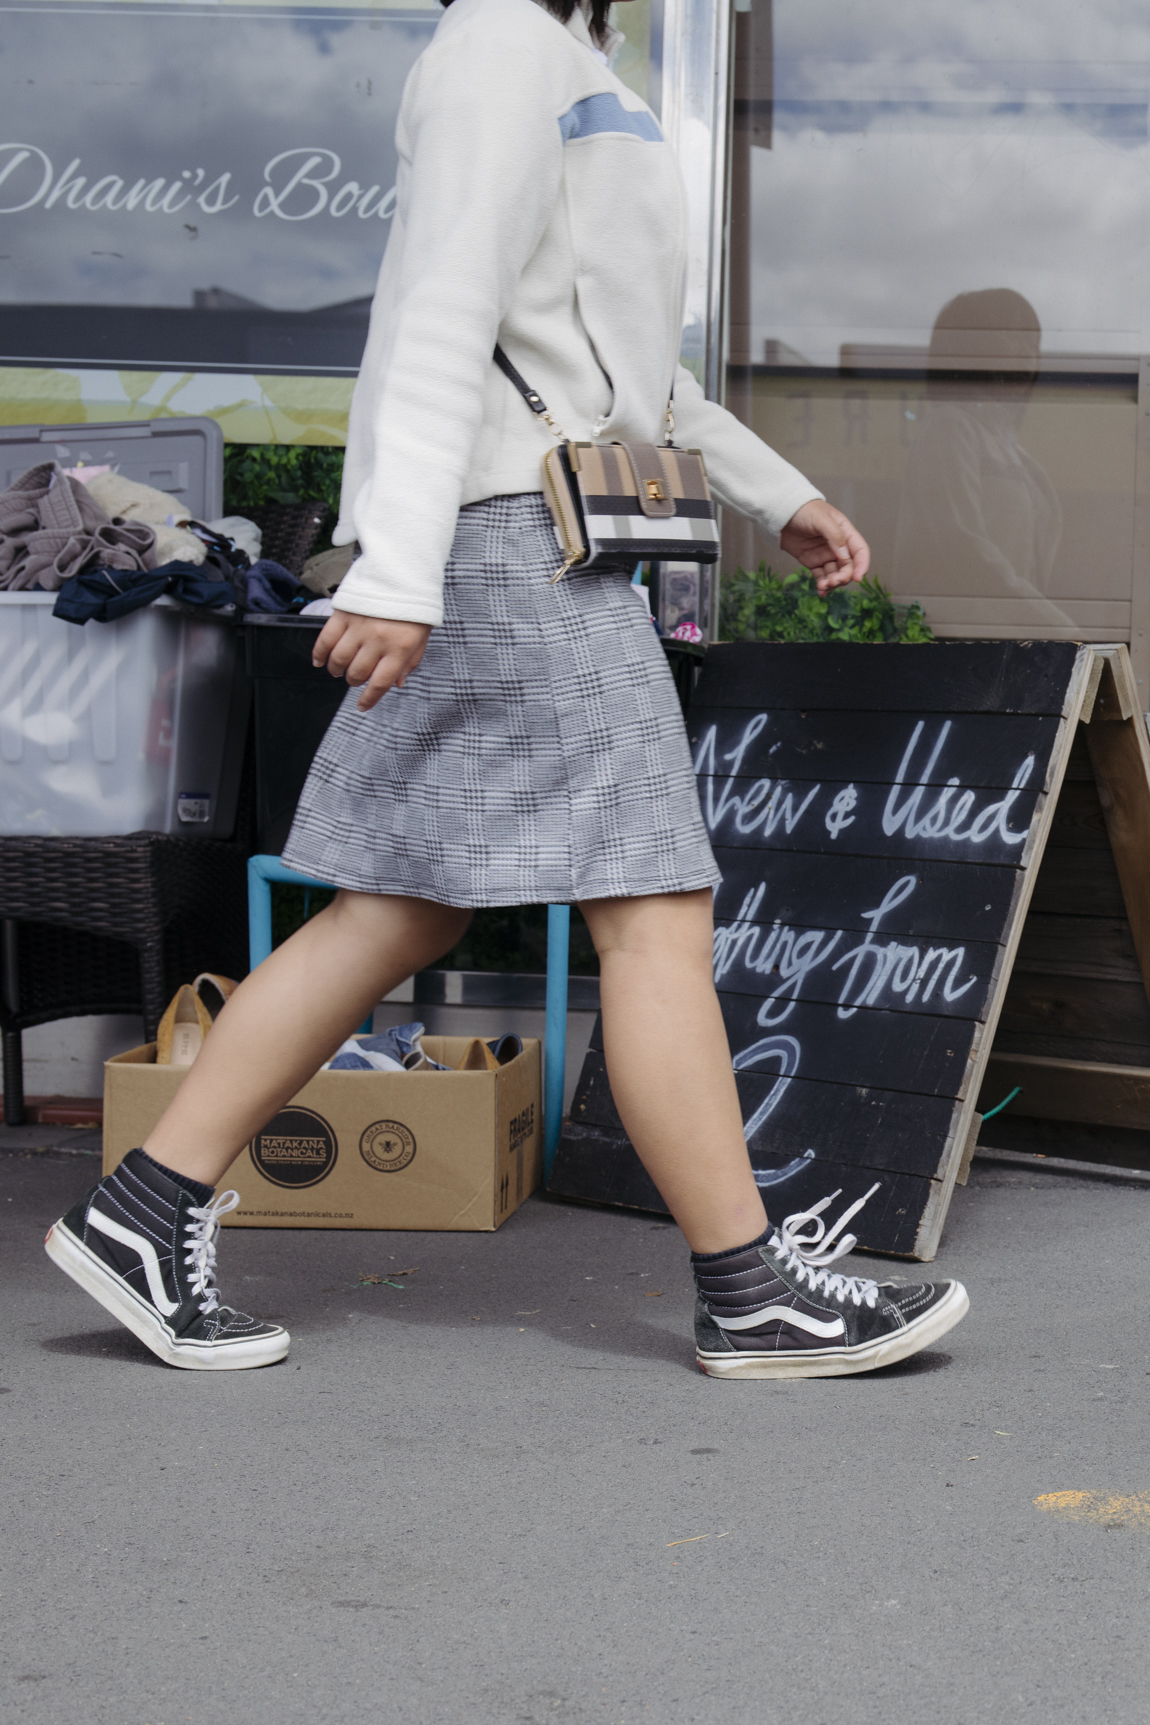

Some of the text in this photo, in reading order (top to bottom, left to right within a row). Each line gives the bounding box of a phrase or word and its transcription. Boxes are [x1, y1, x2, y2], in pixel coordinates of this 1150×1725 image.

[0, 142, 240, 214] Dhani's
[694, 713, 821, 837] New
[882, 720, 1036, 844] Used
[713, 875, 977, 1027] othing from
[261, 1139, 326, 1149] MATAKANA
[261, 1148, 327, 1158] BOTANICALS
[236, 1209, 354, 1219] www.matakanabotanicals.co.nz
